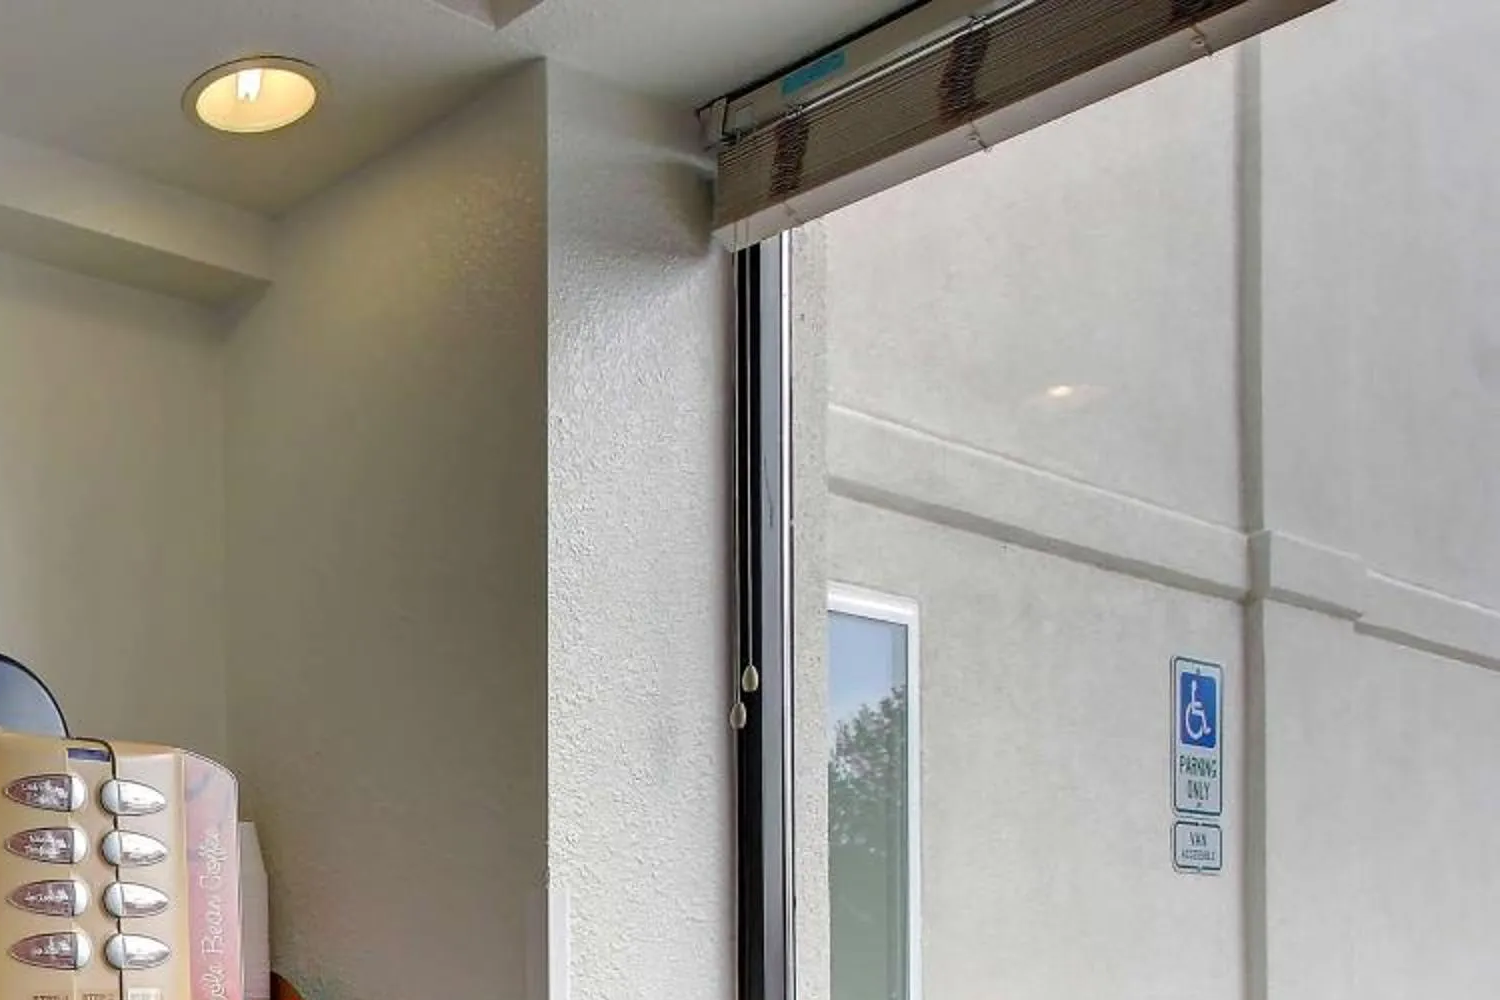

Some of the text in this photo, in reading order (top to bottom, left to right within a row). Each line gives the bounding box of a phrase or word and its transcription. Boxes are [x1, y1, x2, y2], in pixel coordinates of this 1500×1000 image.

[1179, 754, 1217, 779] PARKING
[1187, 779, 1210, 801] ONLY
[1188, 831, 1207, 847] VAN
[198, 828, 228, 887] Coffee
[201, 893, 225, 953] Bean
